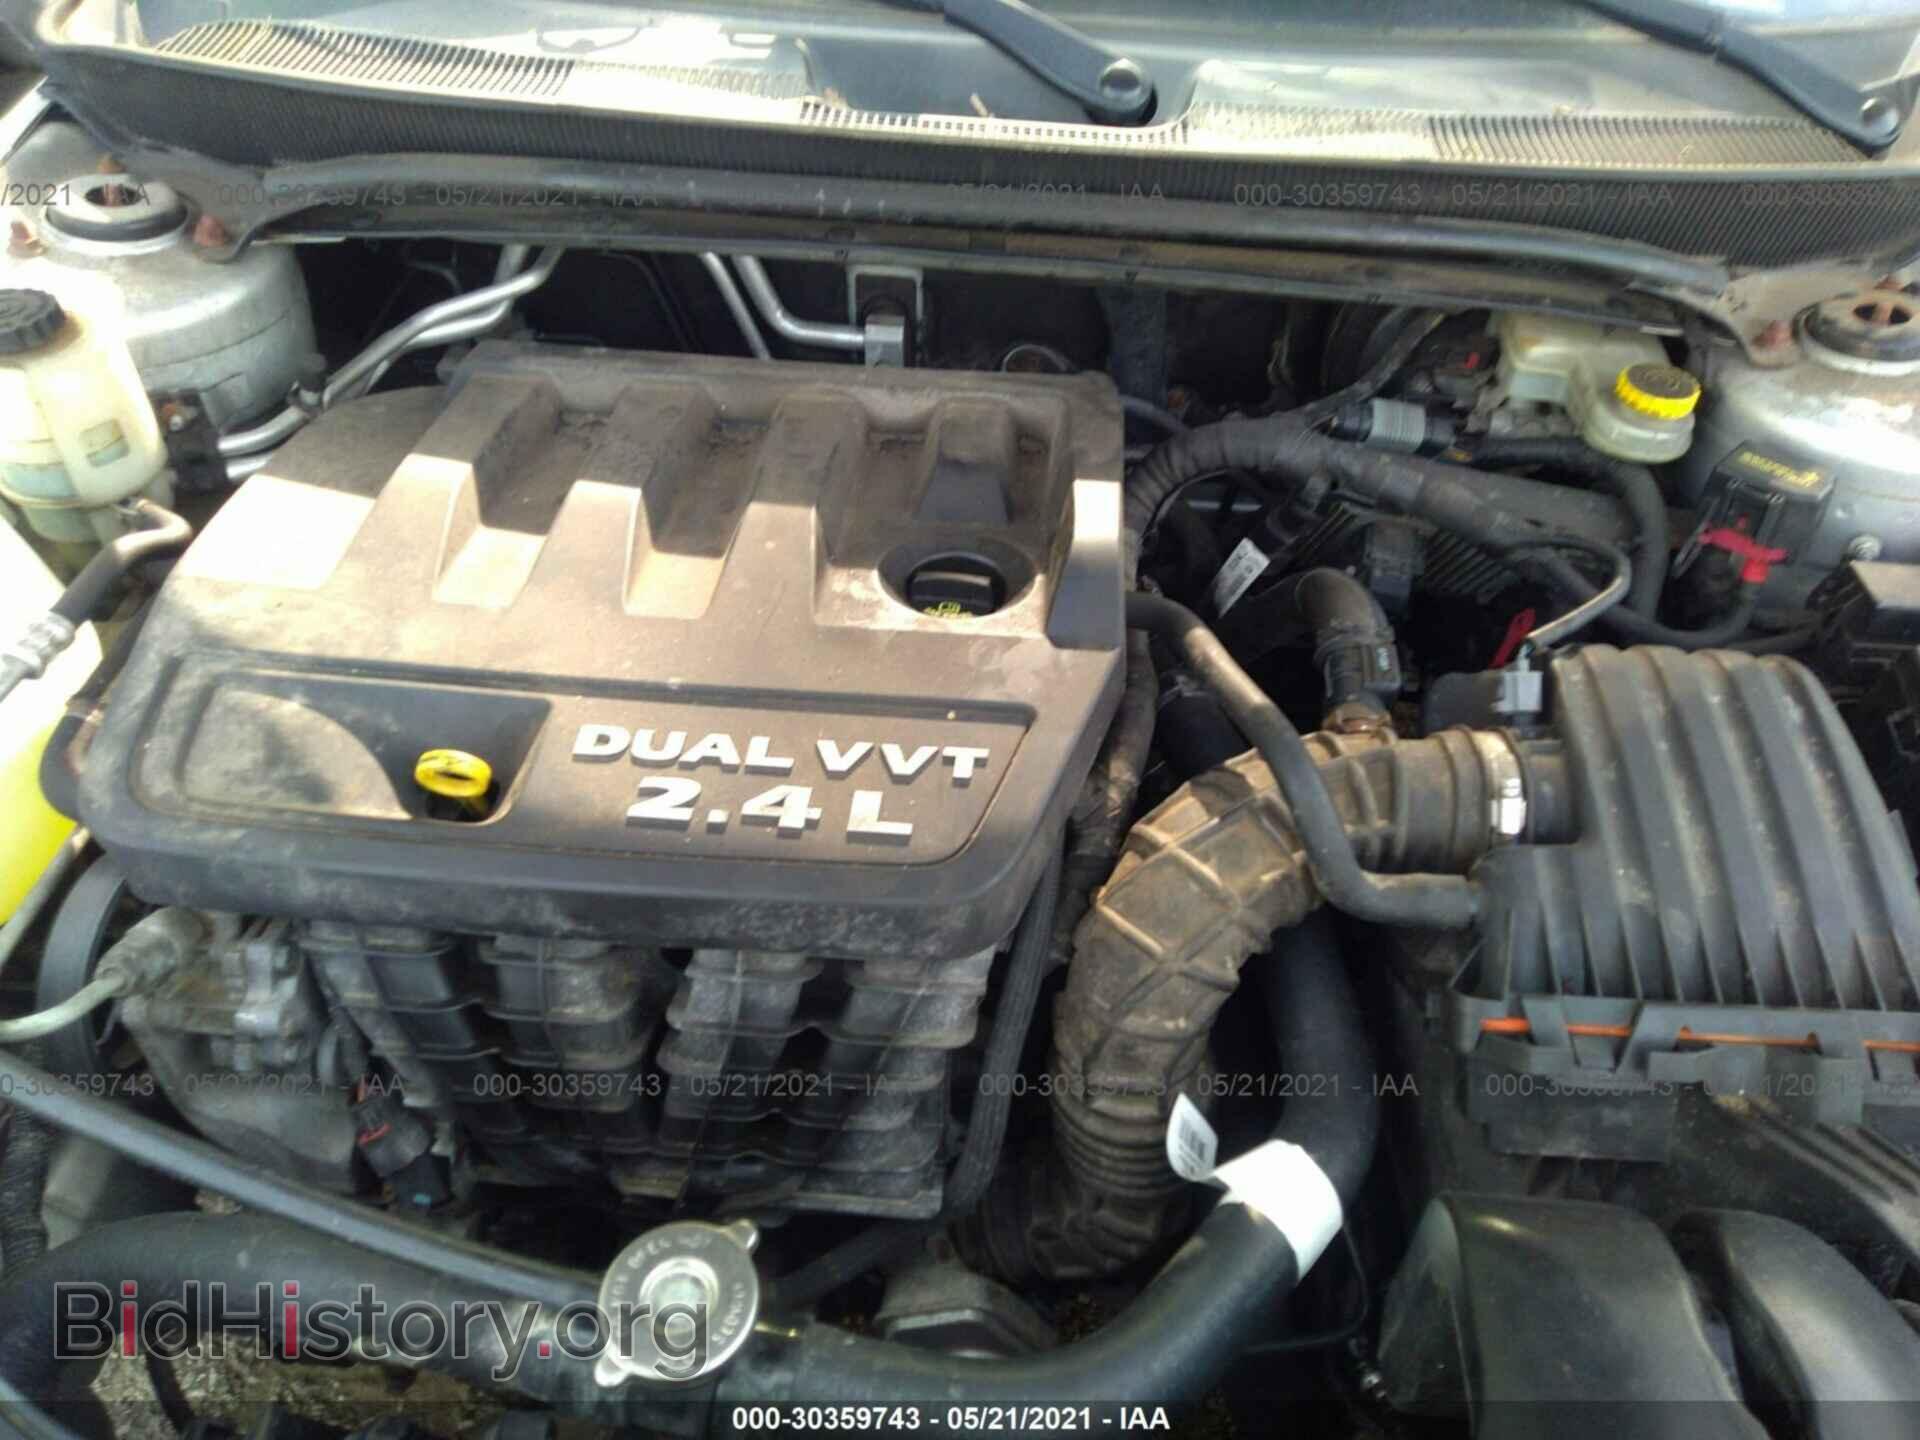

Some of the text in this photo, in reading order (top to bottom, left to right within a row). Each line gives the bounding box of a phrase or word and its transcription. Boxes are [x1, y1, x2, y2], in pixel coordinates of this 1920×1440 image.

[572, 723, 990, 787] DUAL VVT
[625, 776, 914, 845] 2.4 L
